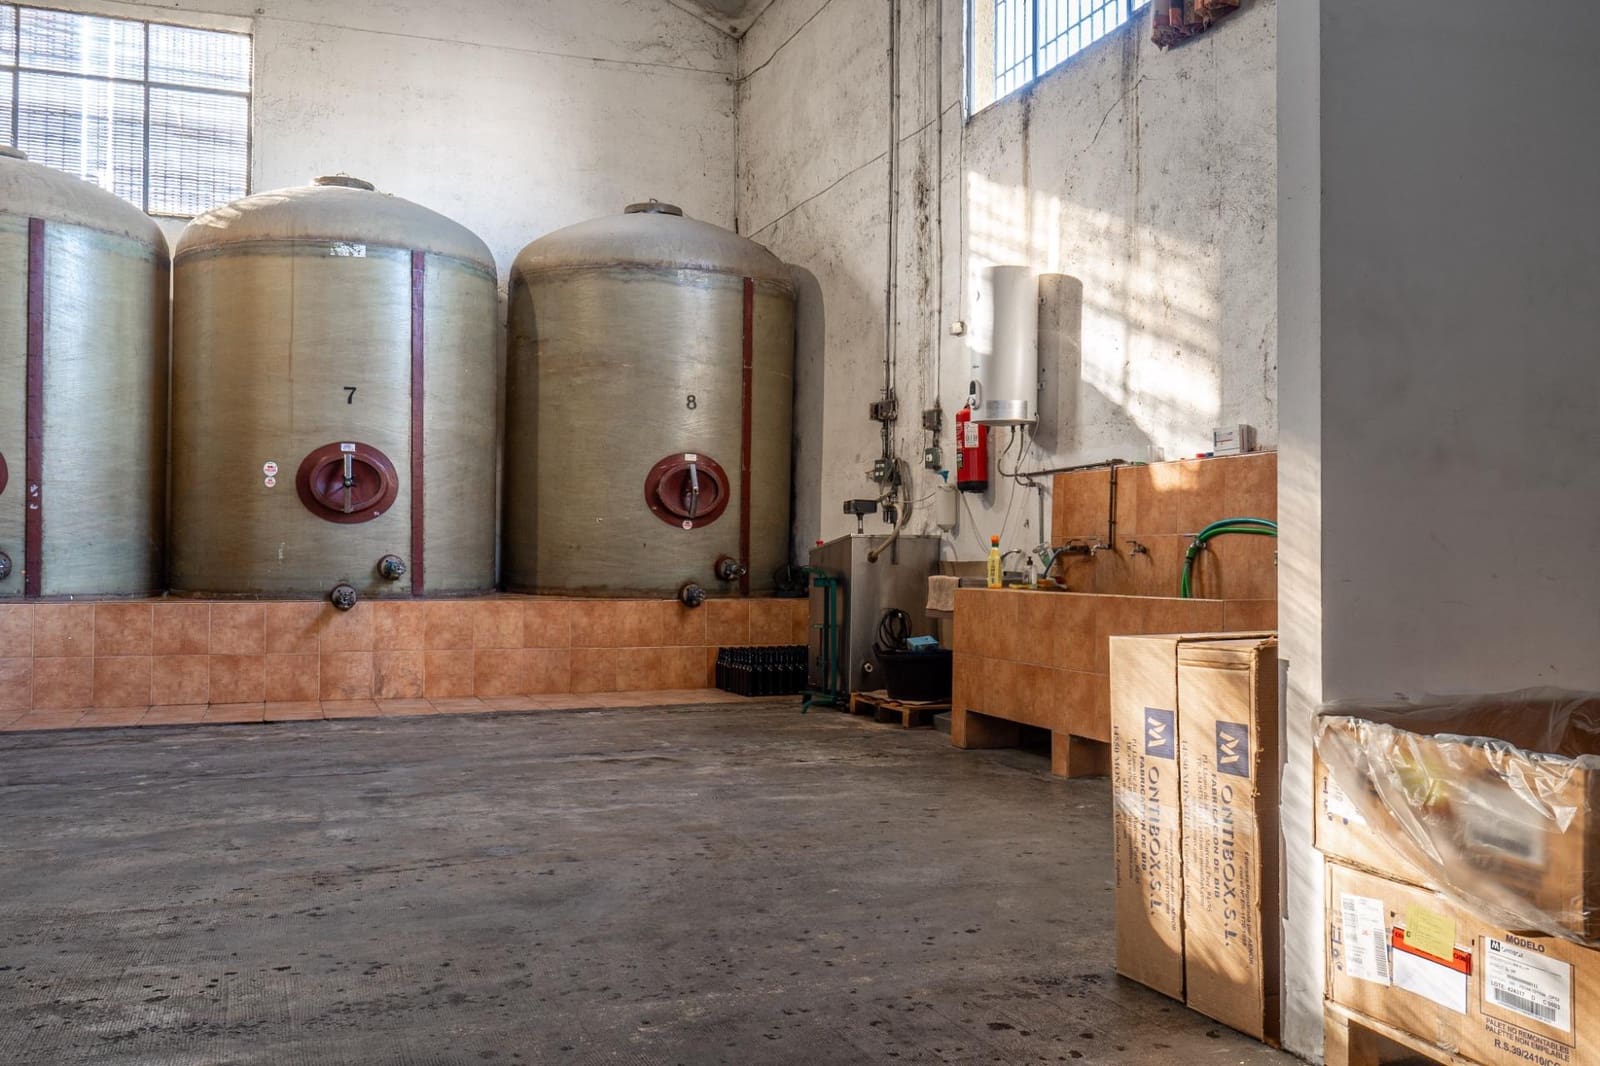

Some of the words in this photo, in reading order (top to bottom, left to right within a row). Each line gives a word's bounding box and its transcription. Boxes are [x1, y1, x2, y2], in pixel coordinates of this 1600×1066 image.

[343, 386, 357, 405] 7
[686, 394, 697, 410] 8
[1213, 858, 1220, 871] DE
[1506, 934, 1545, 953] MODELO
